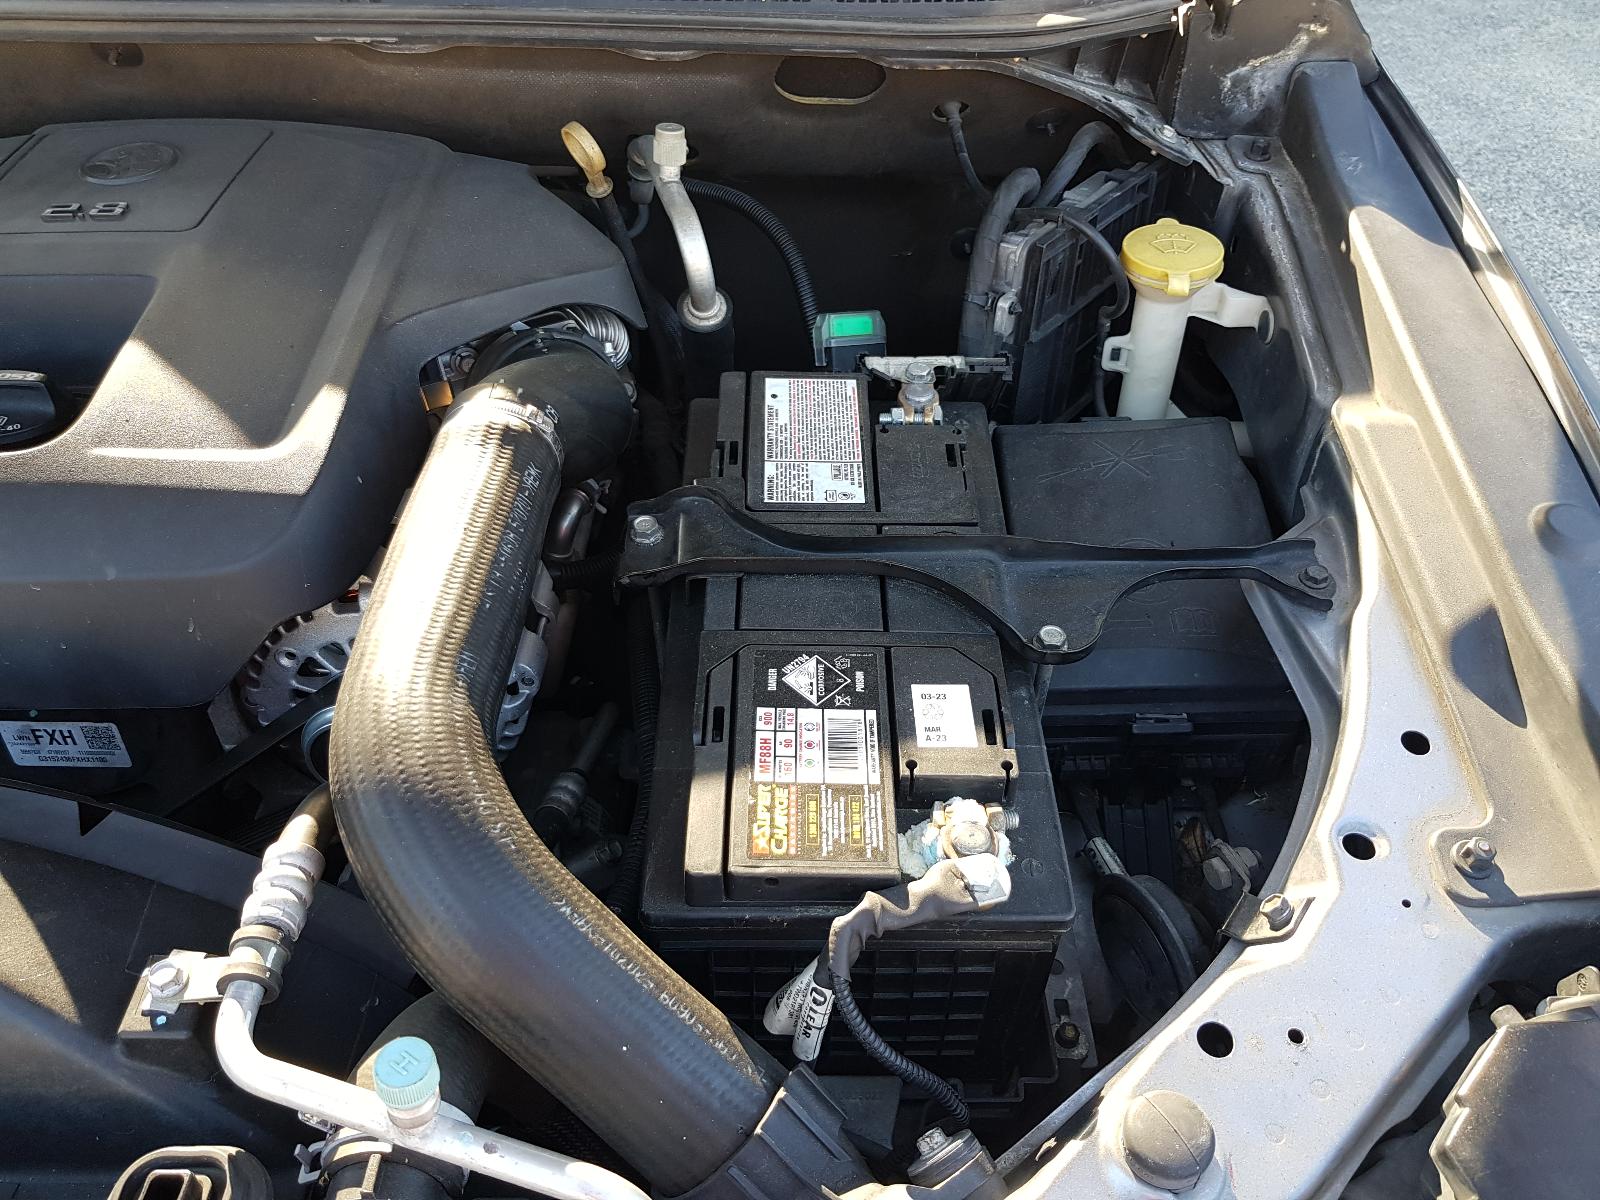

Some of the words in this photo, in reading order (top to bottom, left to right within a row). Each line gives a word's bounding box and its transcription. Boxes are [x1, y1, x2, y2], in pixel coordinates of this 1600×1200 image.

[41, 201, 129, 220] 2.8
[766, 404, 775, 431] STATEMENT
[766, 432, 775, 460] WARRANTY
[766, 474, 775, 501] WARNING:
[782, 653, 810, 674] UN2794
[767, 668, 778, 691] DANGER
[817, 663, 825, 696] CORROSIVE
[855, 671, 865, 692] POISON
[763, 711, 773, 726] 900
[787, 712, 795, 726] 14.8
[30, 728, 79, 746] FXH
[783, 738, 793, 748] 90
[925, 734, 947, 742] A-23
[759, 737, 772, 774] MF88H
[754, 783, 772, 835] SUPER
[770, 787, 789, 855] CHARGE
[801, 1007, 818, 1039] LEAR
[389, 1050, 419, 1076] H
